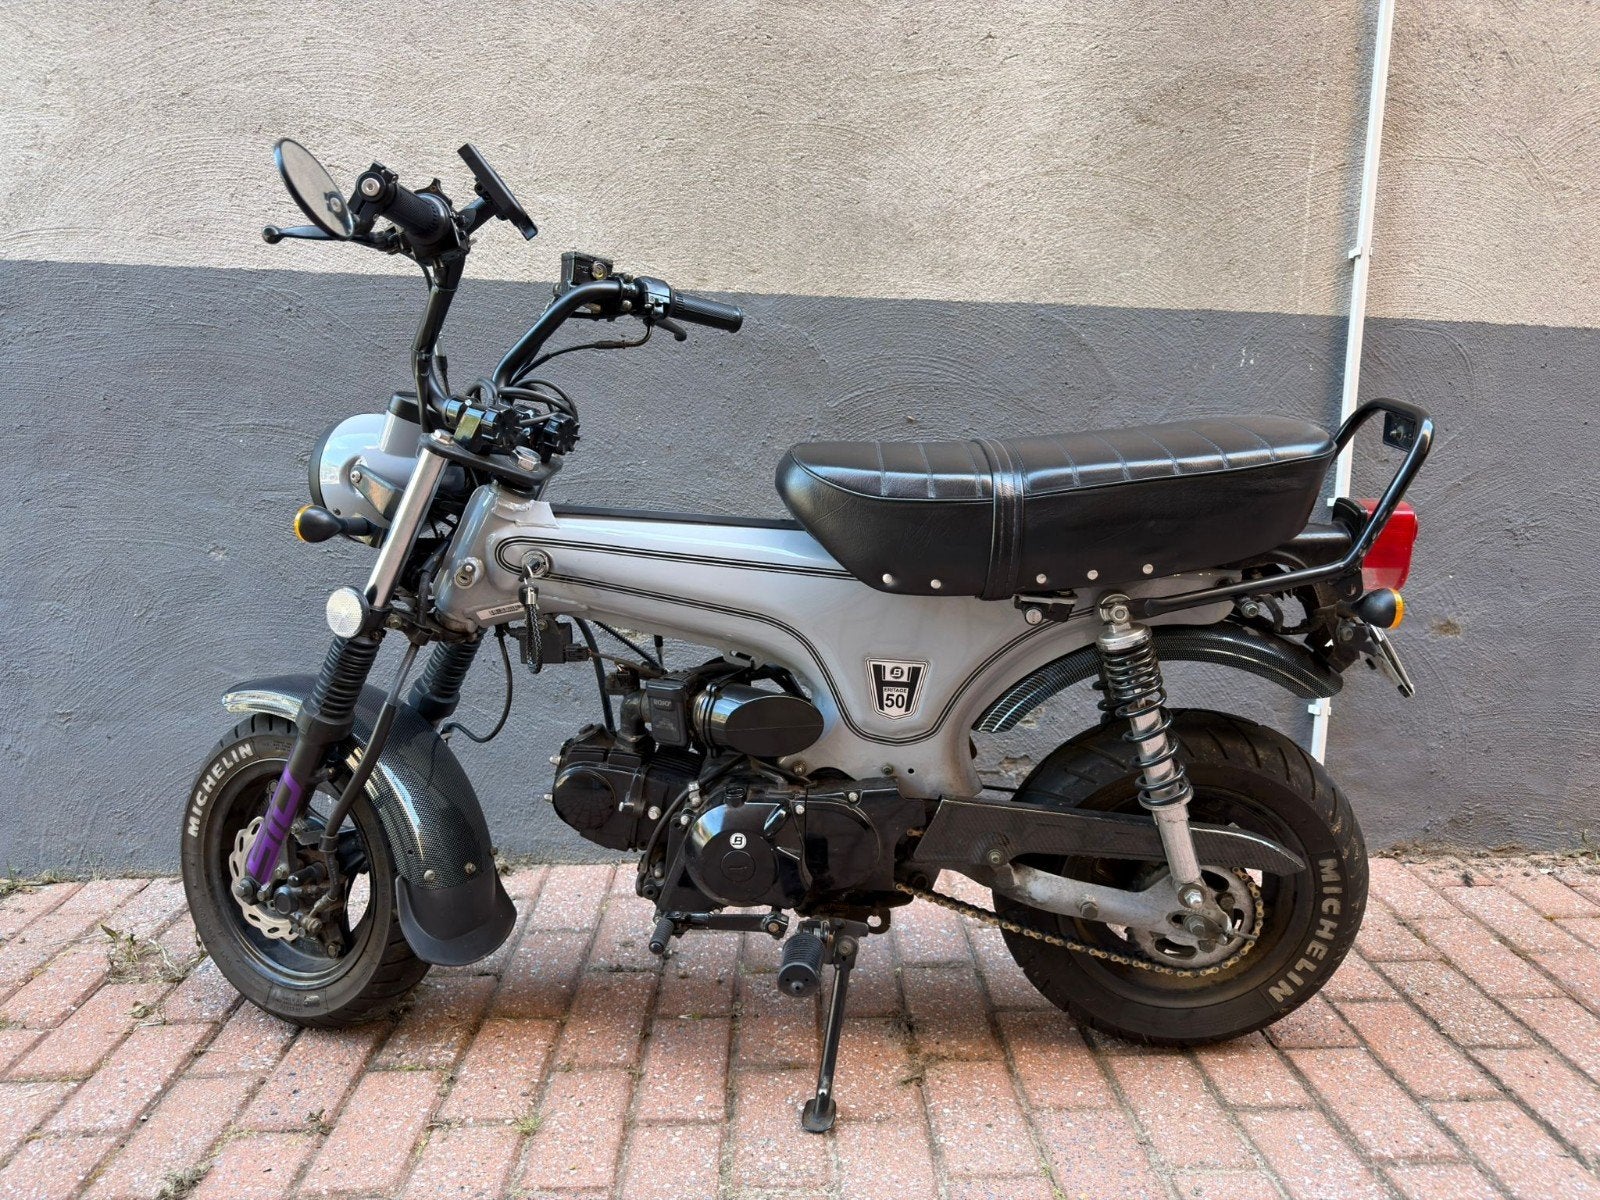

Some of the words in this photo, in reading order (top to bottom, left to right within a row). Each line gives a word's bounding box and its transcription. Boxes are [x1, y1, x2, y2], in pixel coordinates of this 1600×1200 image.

[885, 693, 905, 708] 50
[188, 743, 253, 838] MICHELIN
[1268, 858, 1343, 1003] MICHELIN
